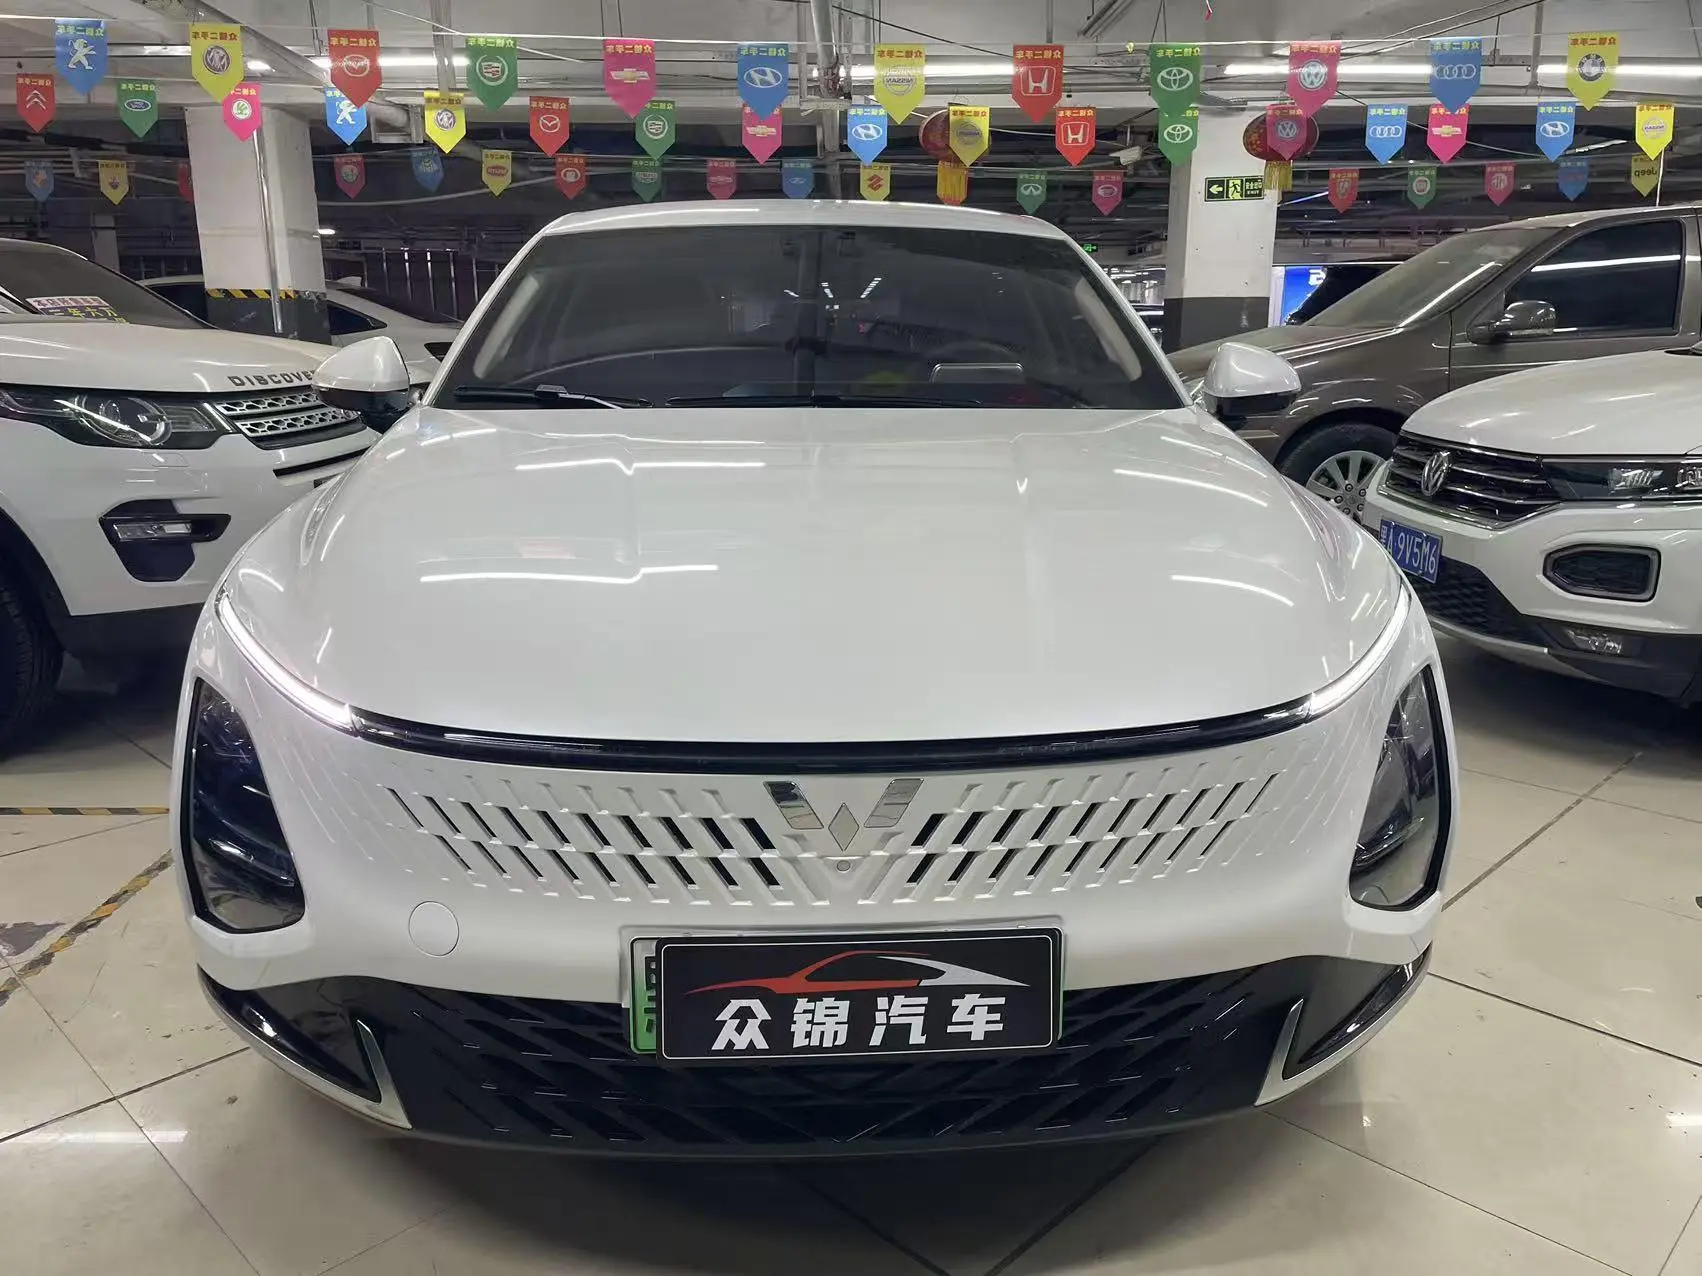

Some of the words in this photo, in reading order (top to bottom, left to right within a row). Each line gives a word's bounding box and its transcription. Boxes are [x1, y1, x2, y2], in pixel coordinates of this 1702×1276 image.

[227, 369, 316, 386] DISCOVE
[711, 993, 1006, 1050] 众锦汽车
